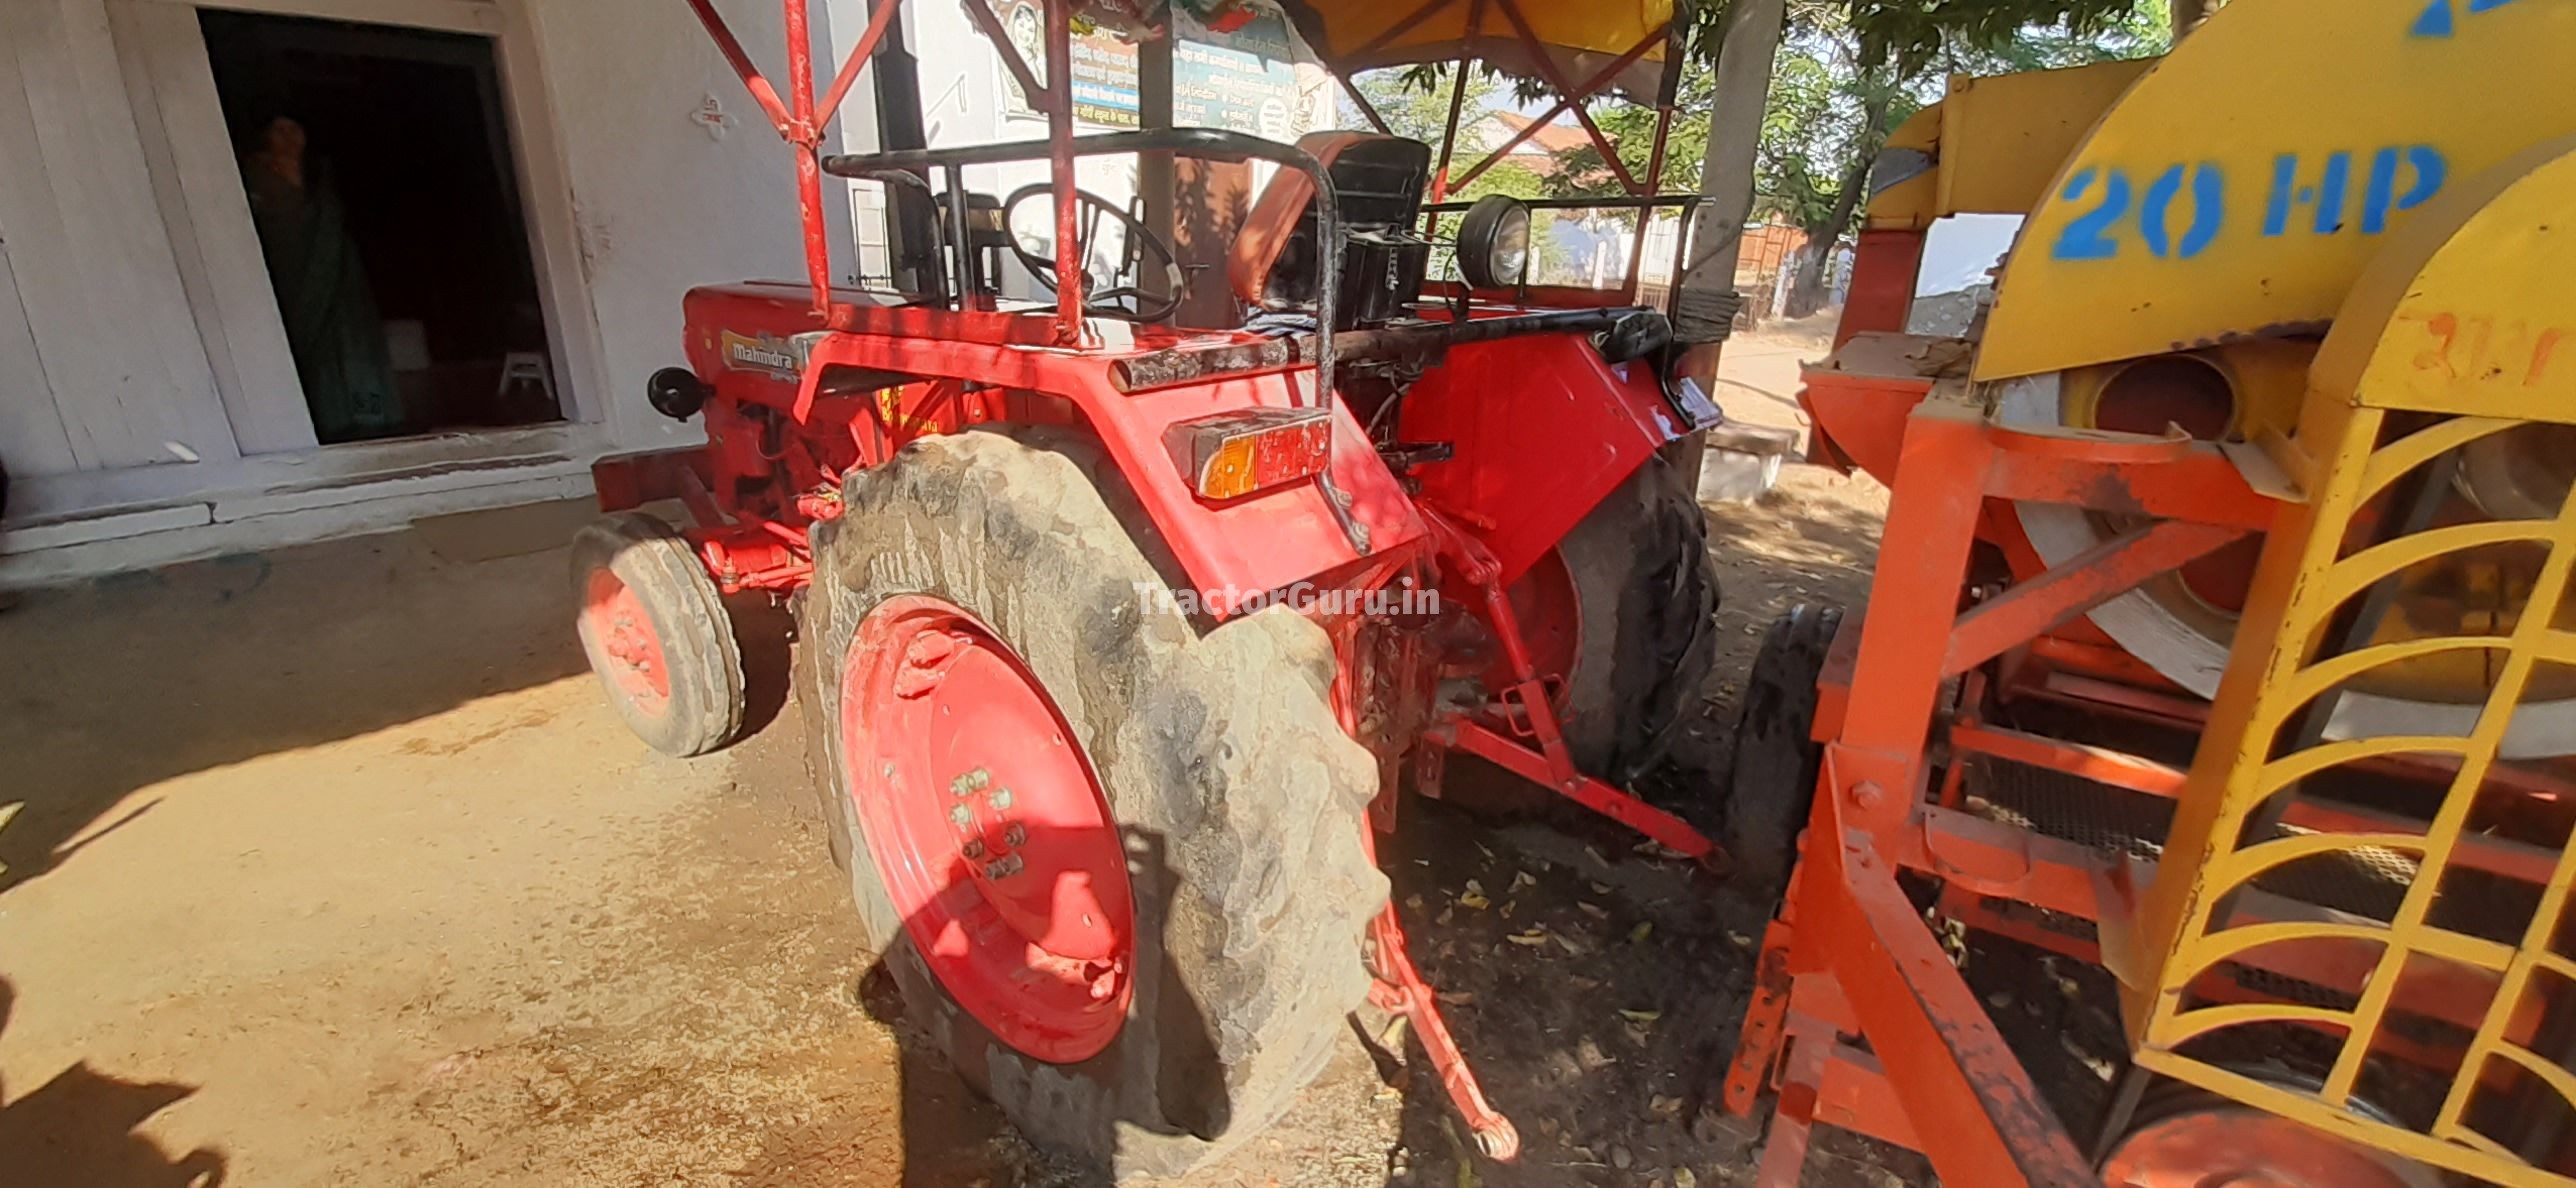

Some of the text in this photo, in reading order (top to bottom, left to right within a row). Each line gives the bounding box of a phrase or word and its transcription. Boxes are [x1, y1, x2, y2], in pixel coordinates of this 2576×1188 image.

[2050, 144, 2448, 260] 20 HP
[732, 342, 793, 369] Mahindra
